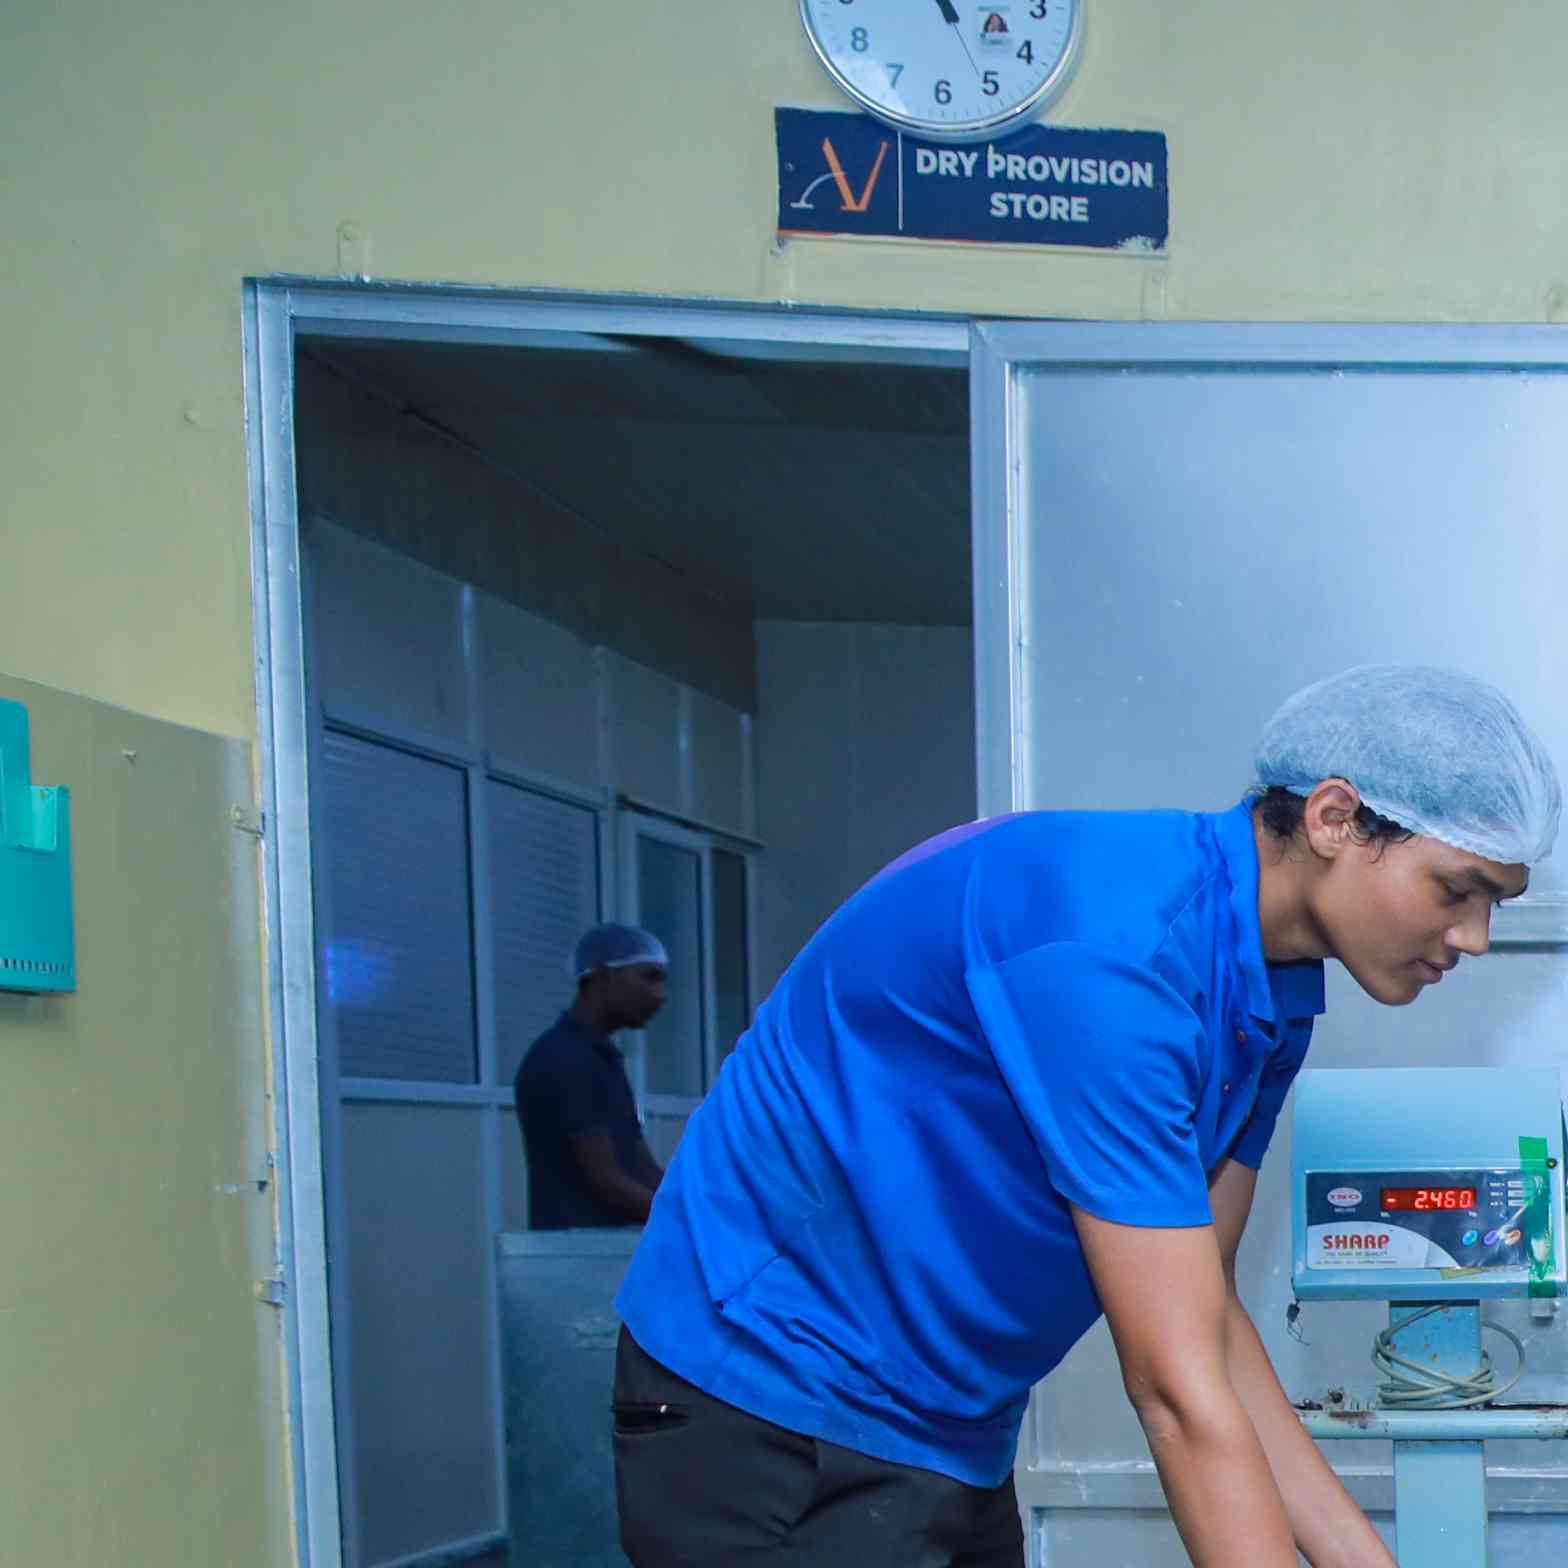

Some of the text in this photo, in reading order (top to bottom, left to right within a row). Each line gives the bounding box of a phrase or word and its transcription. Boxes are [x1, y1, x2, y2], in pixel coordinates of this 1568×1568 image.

[851, 27, 868, 52] 8
[1016, 40, 1034, 64] 4
[886, 63, 904, 89] 7
[983, 70, 999, 96] 5
[934, 80, 952, 104] 6
[916, 149, 1154, 188] DRY PROVISION
[990, 193, 1089, 222] STORE
[1322, 1233, 1390, 1249] SHARP
